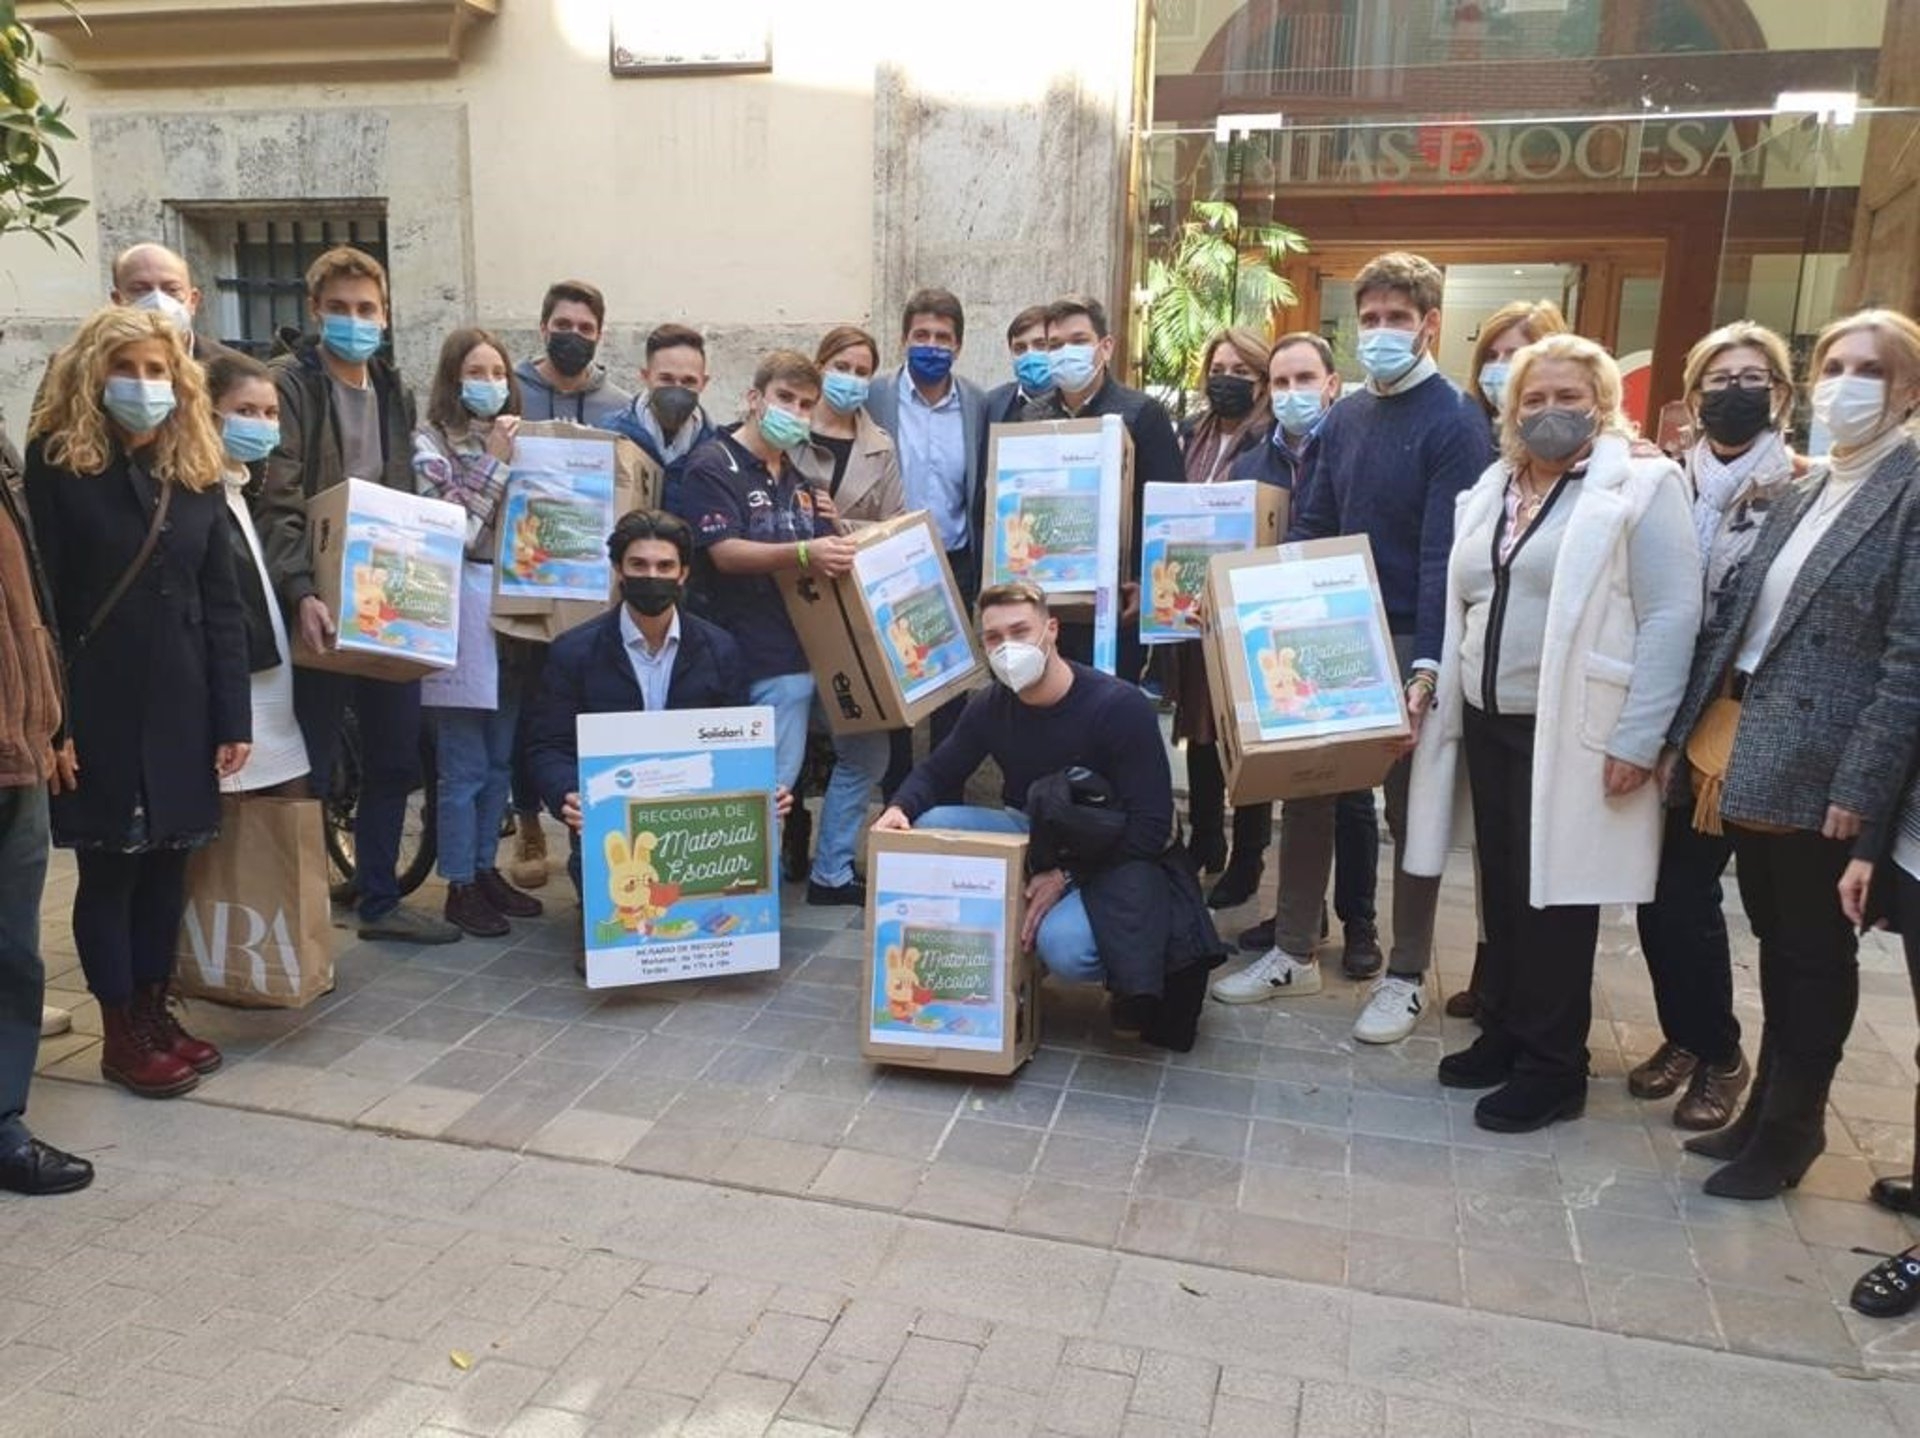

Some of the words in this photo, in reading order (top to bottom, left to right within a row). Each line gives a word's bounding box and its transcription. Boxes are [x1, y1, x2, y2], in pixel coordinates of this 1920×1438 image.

[1150, 129, 1411, 185] CAITAS
[1438, 117, 1842, 183] DIOCESANA
[697, 725, 744, 740] Solidari
[638, 806, 721, 823] RECOGIDA
[725, 804, 746, 817] DE
[657, 820, 758, 859] Material
[665, 854, 752, 884] Escolar
[178, 899, 300, 996] ARA
[920, 948, 989, 970] Material
[924, 973, 985, 990] Escolar
